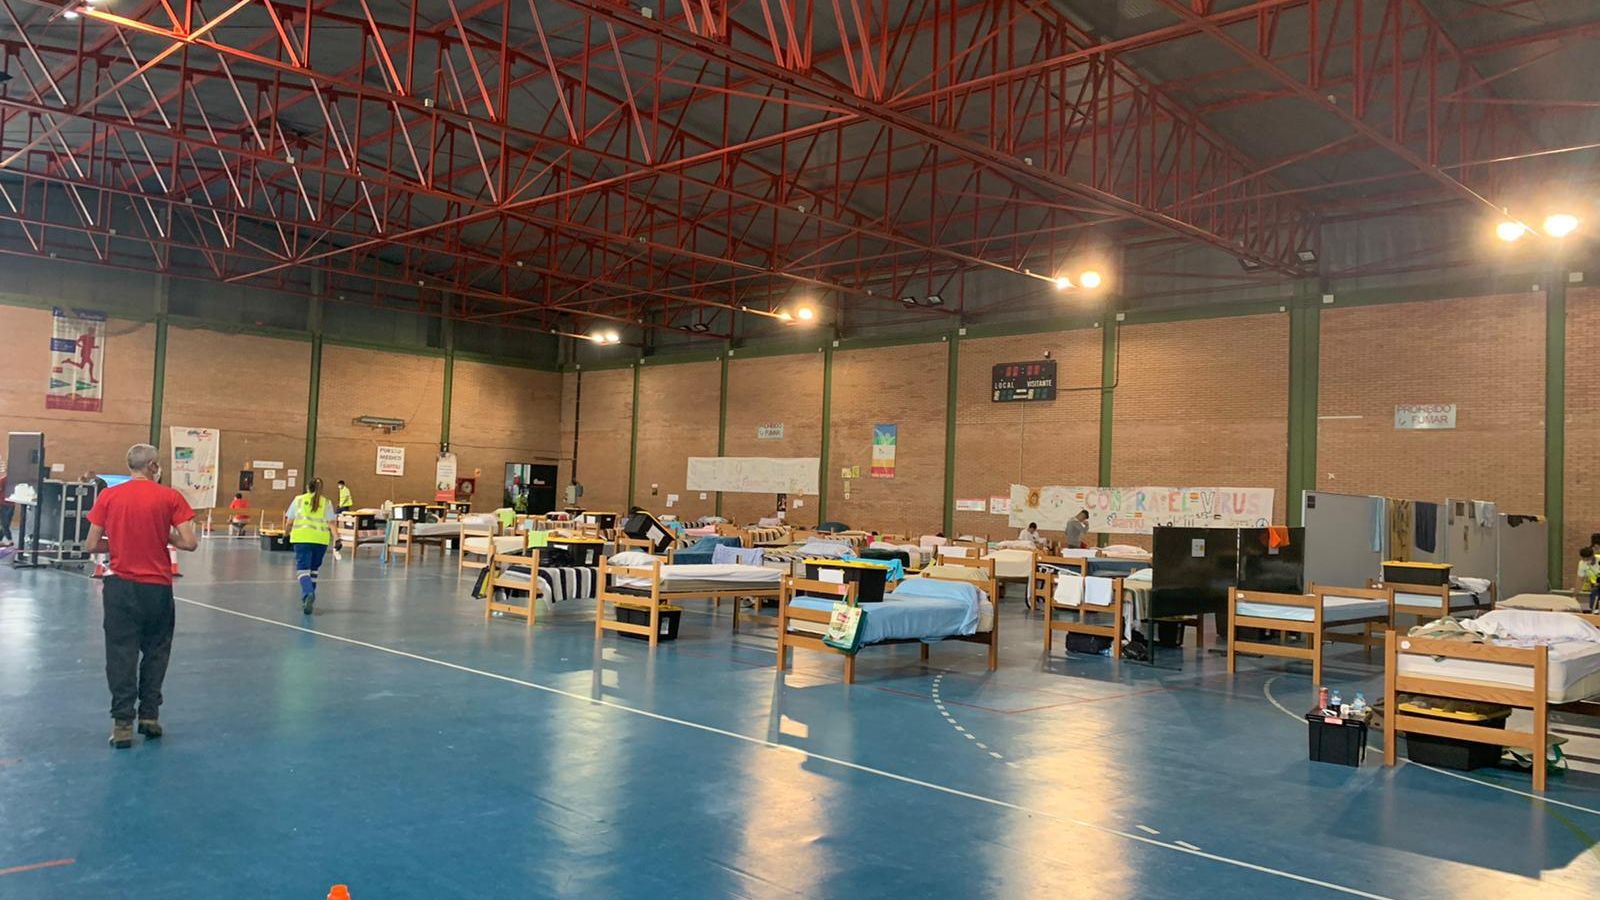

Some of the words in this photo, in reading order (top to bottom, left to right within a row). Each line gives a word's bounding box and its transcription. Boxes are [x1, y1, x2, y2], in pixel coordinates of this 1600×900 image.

[994, 381, 1015, 389] LOCAL
[1026, 379, 1053, 387] VISITANTE
[1411, 415, 1449, 425] FUMAR
[1168, 492, 1189, 512] EL
[1200, 491, 1262, 515] VIRUS
